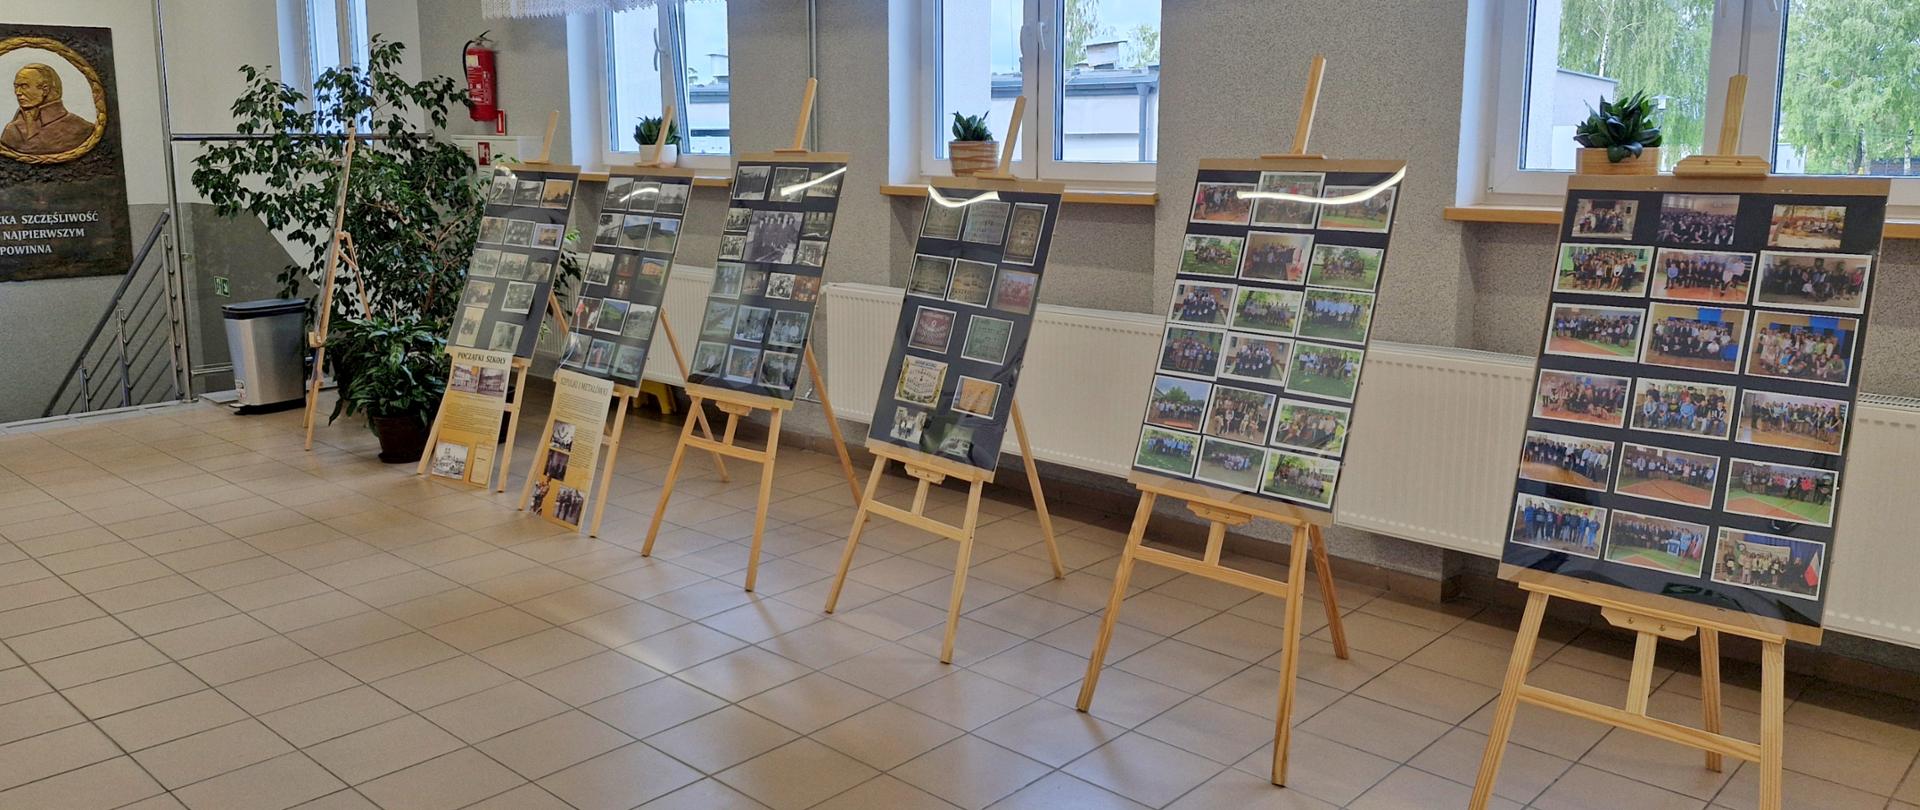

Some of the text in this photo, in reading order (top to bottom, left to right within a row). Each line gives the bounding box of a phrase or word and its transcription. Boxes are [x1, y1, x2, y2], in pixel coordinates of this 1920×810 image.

[0, 211, 98, 225] KA SZCZĘŚLIWOŚĆ
[3, 229, 84, 240] NAJPIERWSZYM
[0, 245, 52, 255] POWINNA
